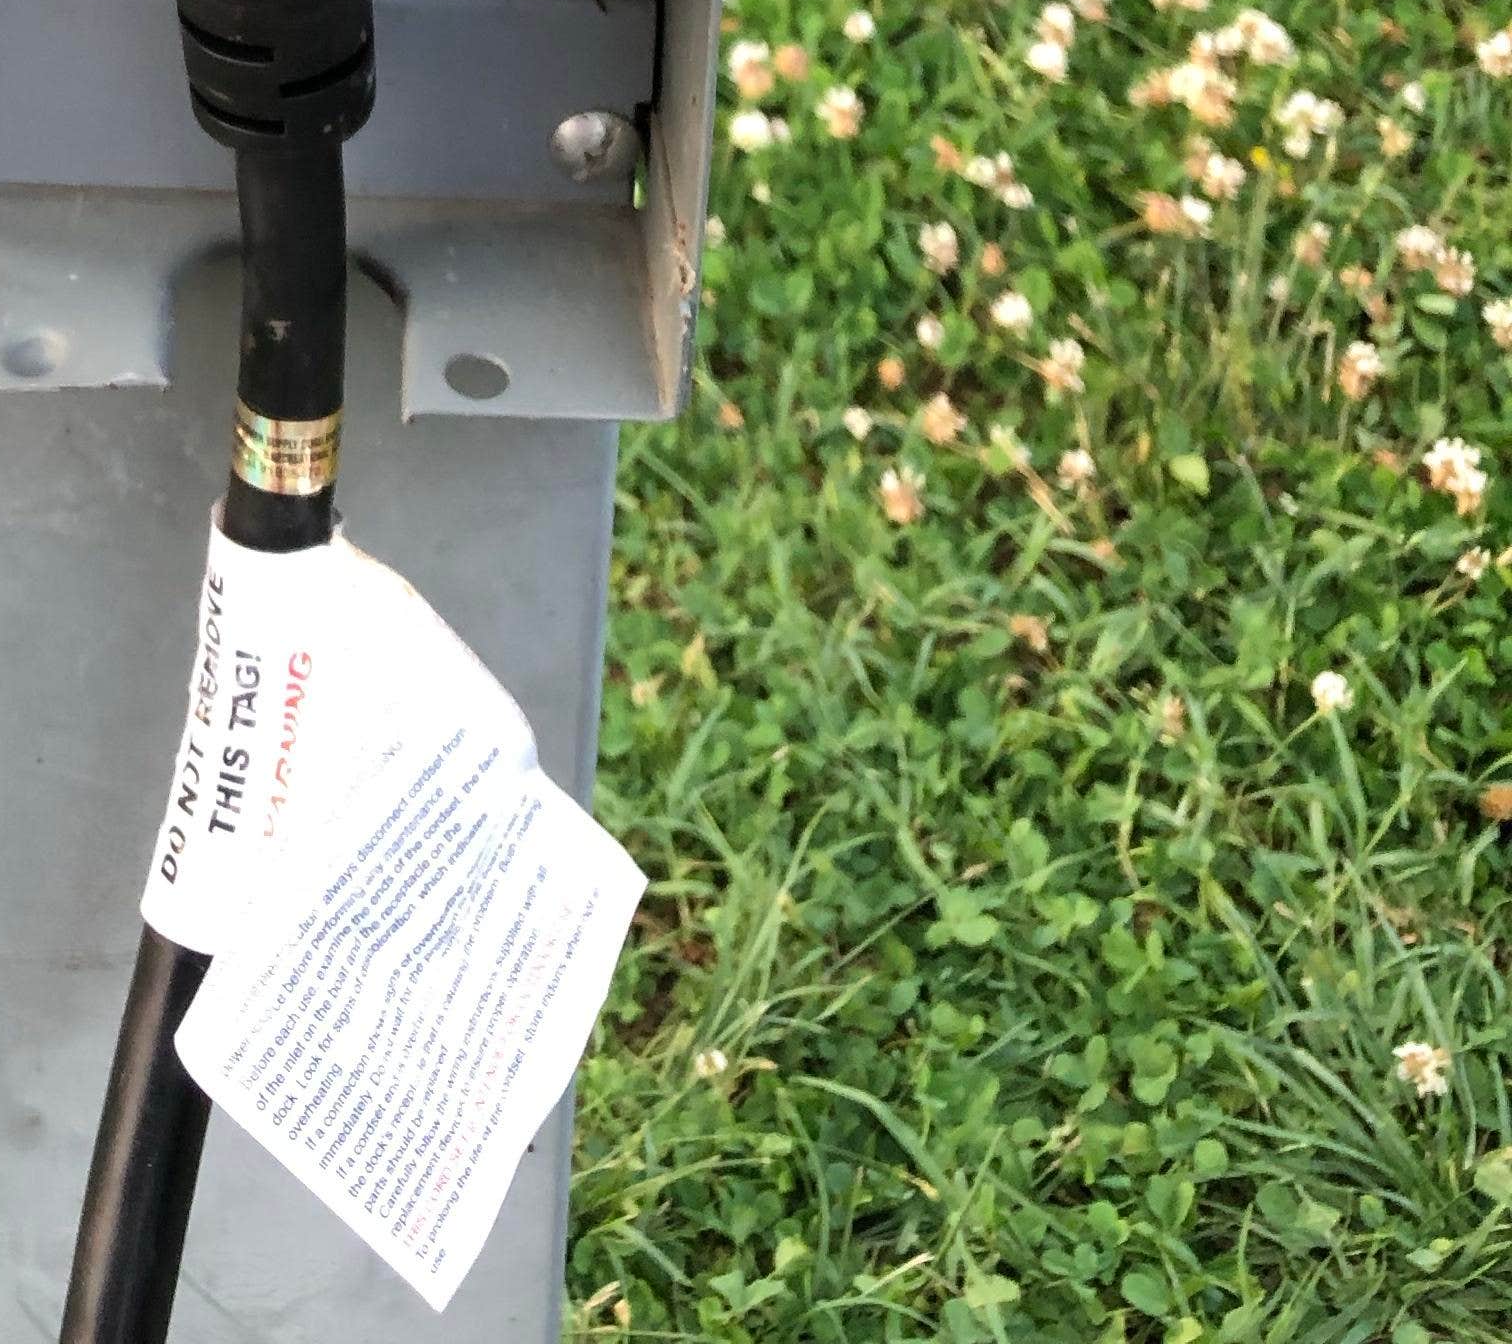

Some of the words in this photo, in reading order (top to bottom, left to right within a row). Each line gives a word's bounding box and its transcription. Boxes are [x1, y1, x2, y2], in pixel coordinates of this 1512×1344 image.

[160, 824, 187, 886] DO
[194, 572, 225, 728] REMOVE
[228, 649, 262, 731] TAG!
[207, 745, 251, 835] THIS
